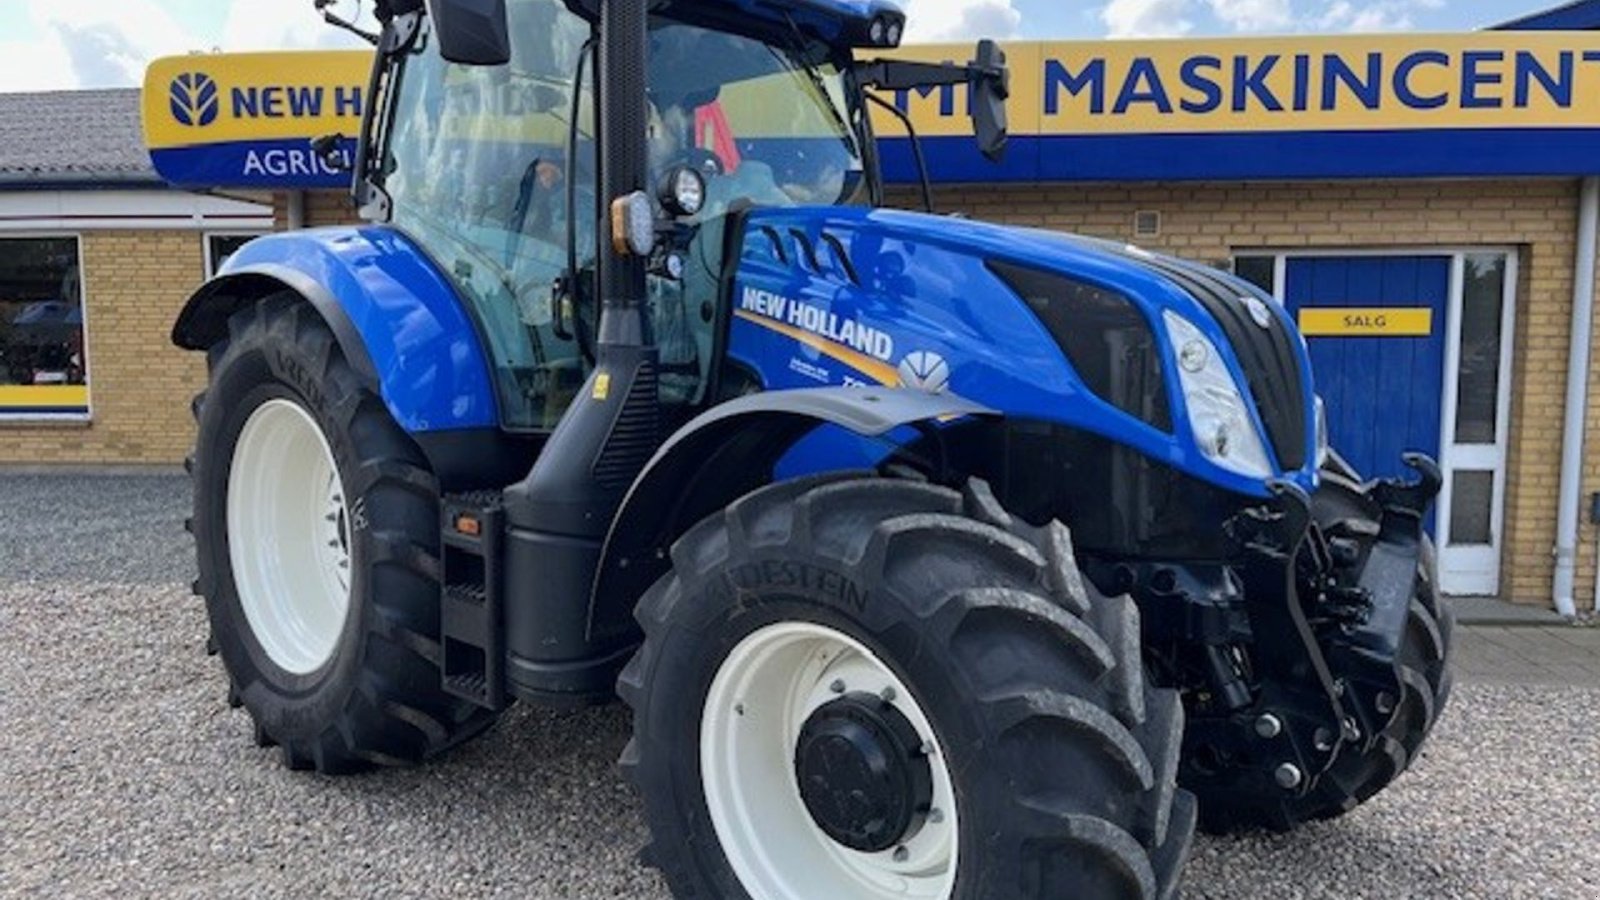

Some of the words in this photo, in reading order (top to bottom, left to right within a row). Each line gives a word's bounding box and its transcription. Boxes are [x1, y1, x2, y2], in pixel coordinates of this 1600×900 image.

[231, 86, 324, 118] NEW
[741, 286, 786, 319] NEW
[788, 298, 894, 362] HOLLAND
[1343, 315, 1387, 328] SALG
